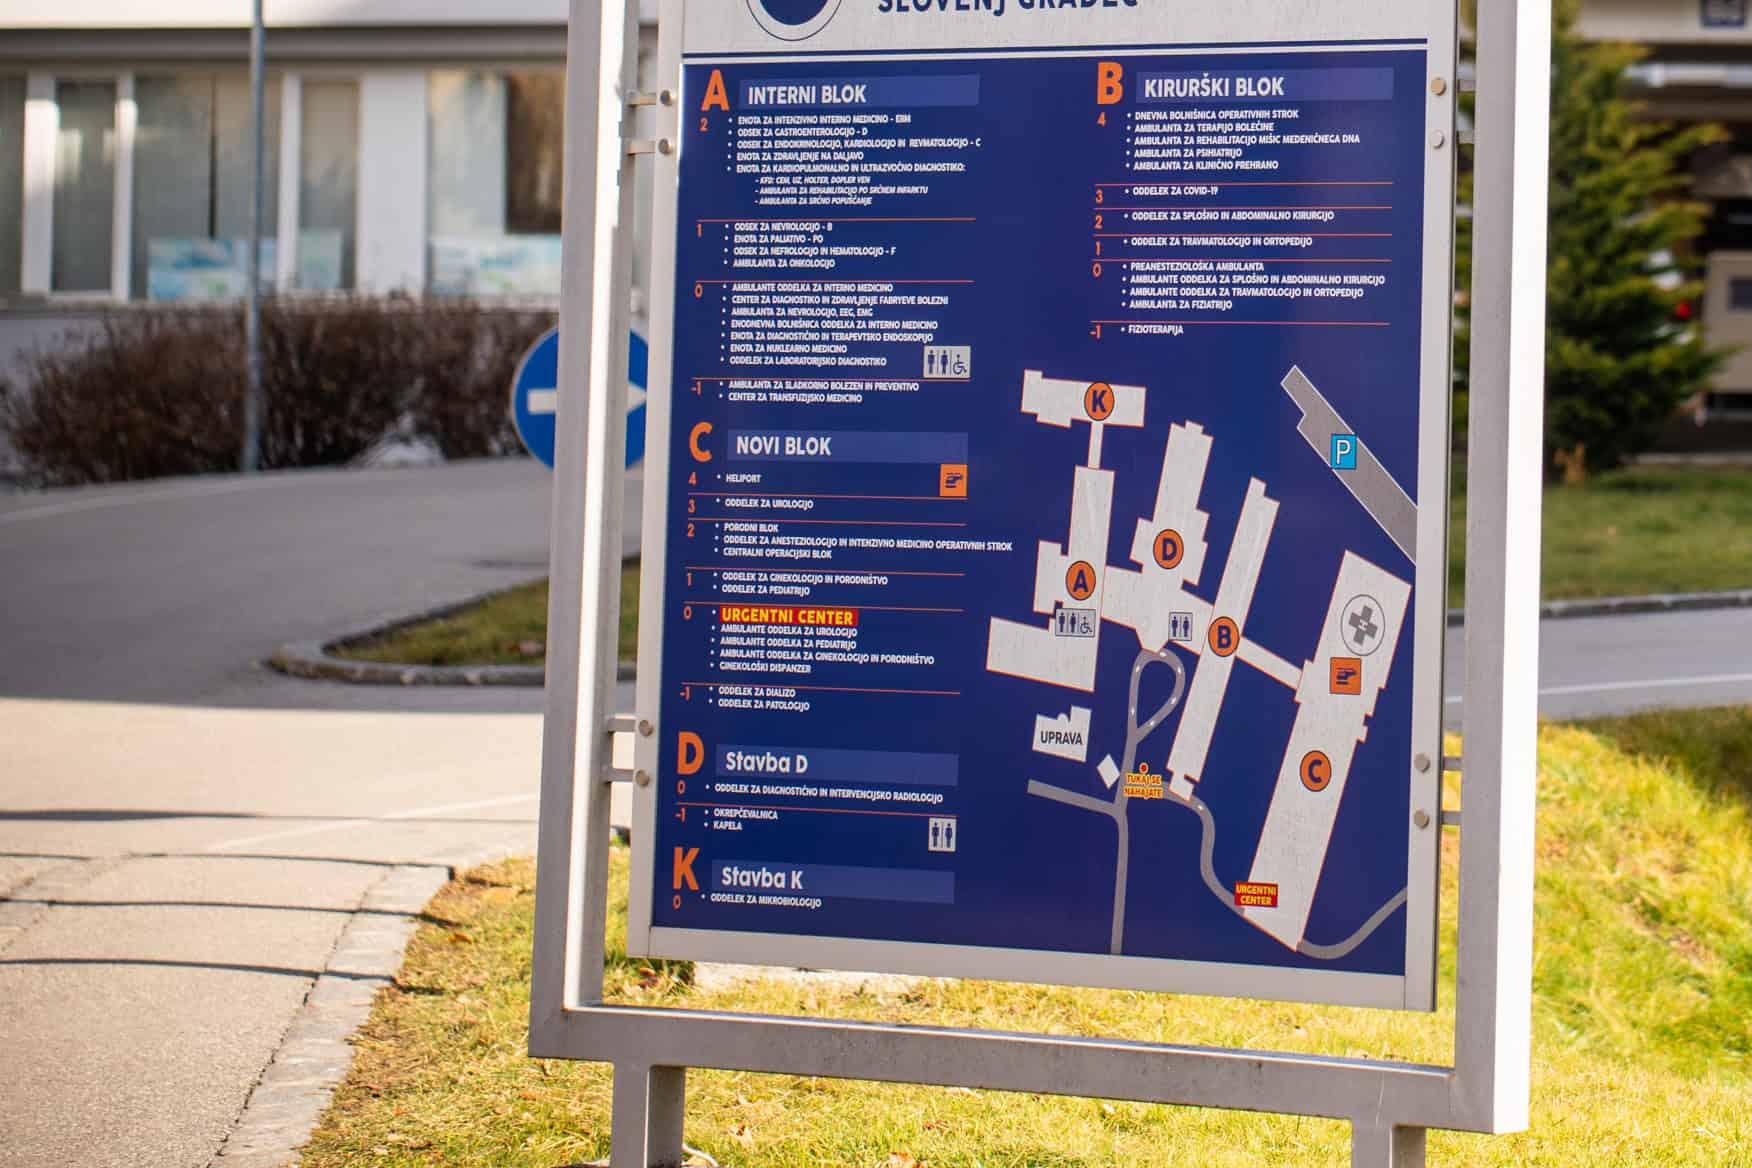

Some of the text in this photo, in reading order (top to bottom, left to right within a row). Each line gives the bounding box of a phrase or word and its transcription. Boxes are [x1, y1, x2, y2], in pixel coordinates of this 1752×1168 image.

[1097, 61, 1124, 105] B
[1144, 73, 1285, 98] KIRURŠKI BLOK
[702, 69, 730, 112] A
[748, 84, 867, 105] INTERNI BLOK
[1183, 124, 1195, 132] ZA
[1183, 136, 1194, 145] ZA
[761, 152, 772, 160] ZA
[820, 152, 832, 160] NA
[1183, 149, 1194, 157] ZA
[1182, 161, 1194, 170] ZA
[1170, 187, 1182, 195] ZA
[1170, 212, 1181, 220] ZA
[1220, 212, 1230, 220] IN
[1168, 237, 1180, 245] ZA
[1252, 237, 1262, 245] IN
[812, 284, 823, 292] ZA
[760, 296, 771, 304] ZA
[821, 296, 830, 304] IN
[1178, 300, 1190, 309] ZA
[754, 344, 765, 353] ZA
[756, 393, 767, 402] ZA
[1092, 390, 1107, 413] K
[690, 421, 713, 463] C
[736, 436, 832, 456] NOVI BLOK
[1335, 439, 1350, 464] P
[1162, 537, 1177, 561] D
[1073, 569, 1089, 593] A
[757, 585, 768, 594] ZA
[722, 607, 854, 625] URGENTNI CENTER
[803, 627, 814, 635] ZA
[1217, 625, 1232, 649] B
[754, 687, 765, 696] ZA
[753, 700, 764, 709] ZA
[1040, 730, 1083, 745] UPRAVA
[677, 731, 705, 775] D
[726, 751, 808, 774] Stavba D
[1308, 759, 1323, 784] C
[1151, 774, 1162, 786] SE
[750, 785, 761, 794] ZA
[819, 788, 828, 797] IN
[713, 821, 742, 830] KAPELA
[673, 847, 699, 891] K
[721, 866, 804, 890] Stavba K
[1236, 883, 1277, 896] URGENTNI
[746, 895, 757, 904] ZA
[1240, 895, 1272, 906] CENTER
